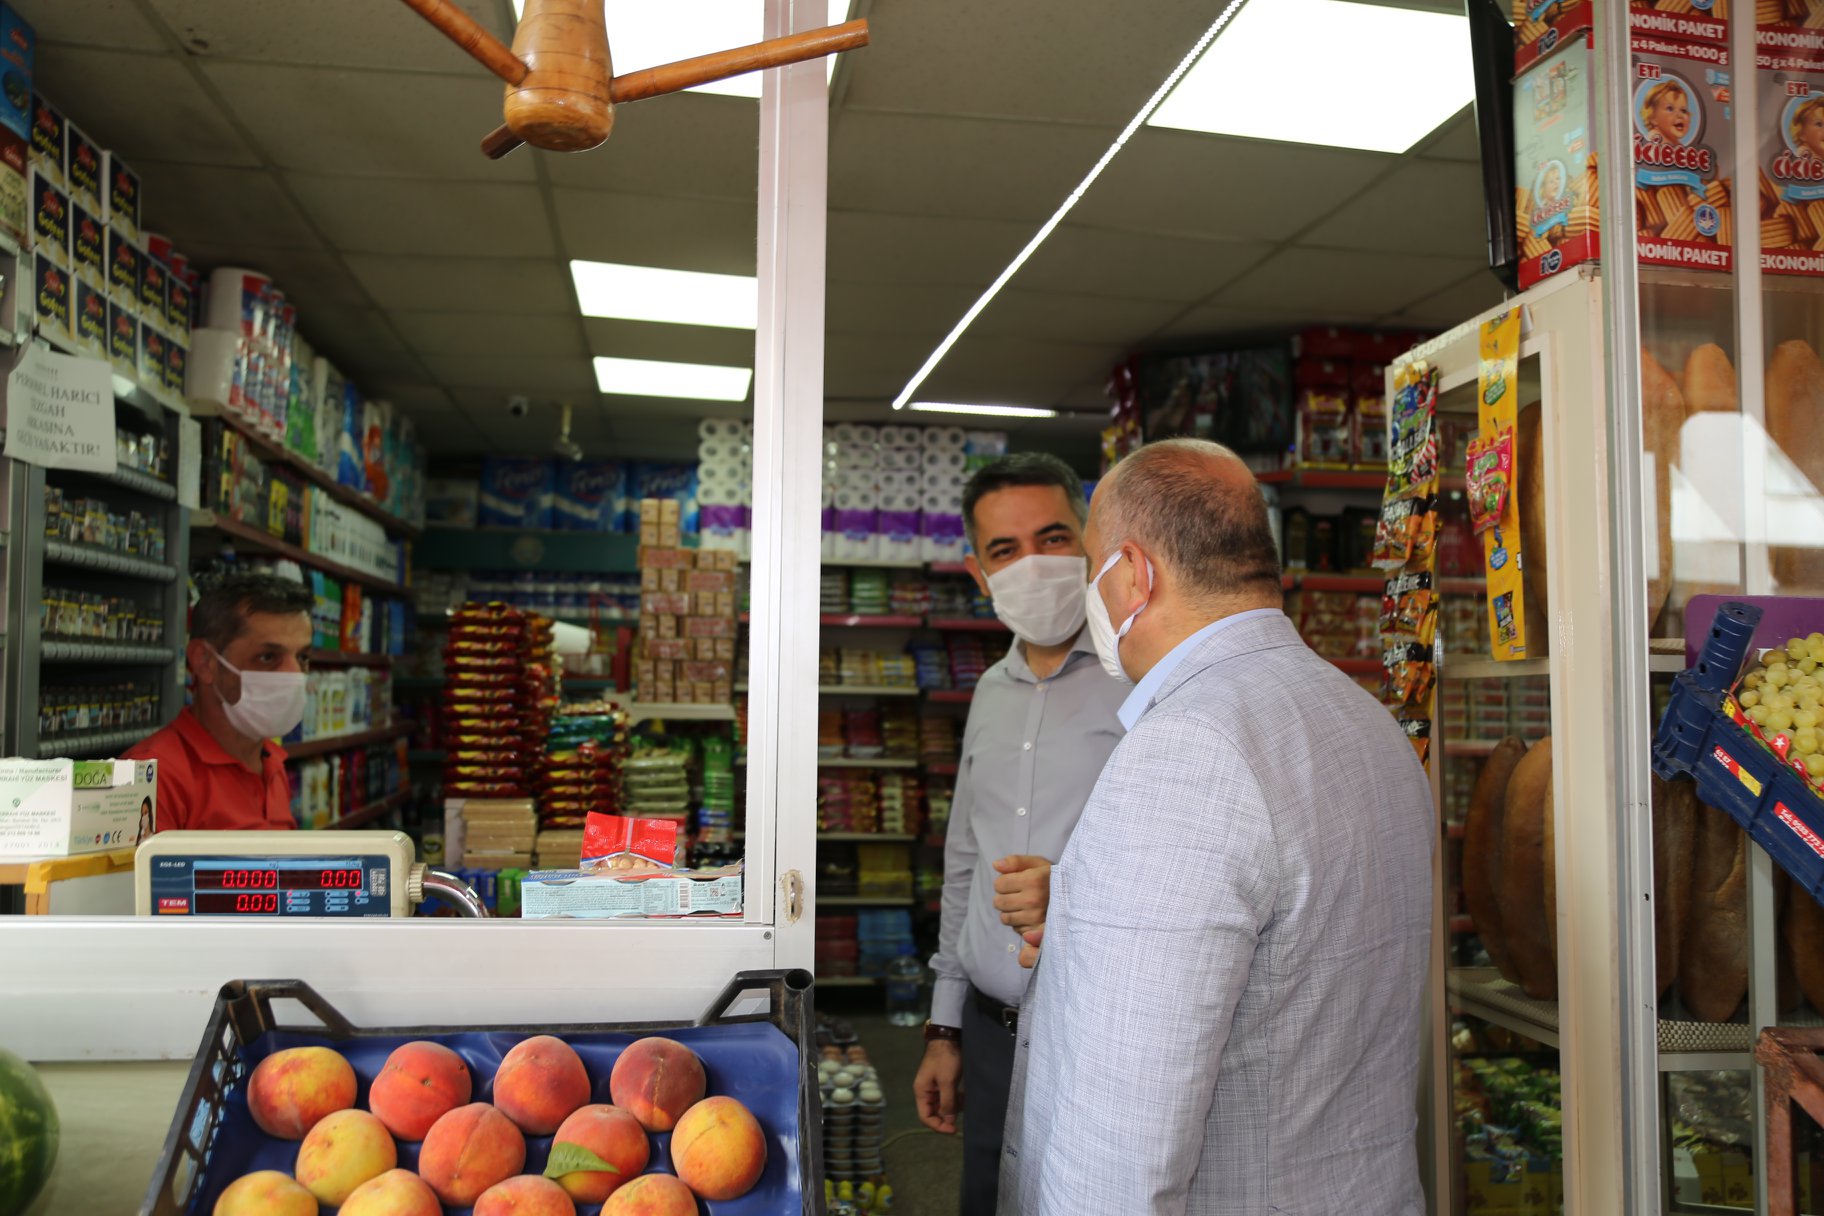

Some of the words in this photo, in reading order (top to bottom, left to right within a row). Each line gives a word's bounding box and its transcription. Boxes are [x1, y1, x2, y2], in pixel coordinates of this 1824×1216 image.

[1630, 13, 1677, 32] NOMİK
[1678, 20, 1725, 39] PAKET
[1640, 38, 1649, 49] 4
[1649, 40, 1678, 54] Paket
[1686, 45, 1718, 60] 1000
[1756, 31, 1824, 49] KONOMİK
[1756, 56, 1771, 66] 50
[1633, 133, 1711, 171] İCİBEBE
[1772, 150, 1824, 180] CİCİB
[1636, 242, 1682, 261] NOMİK
[1683, 248, 1729, 266] PAKET
[1760, 254, 1824, 272] EKONOMİ
[223, 869, 277, 888] 0.000
[321, 870, 361, 888] 0.00
[161, 899, 188, 907] TEM
[236, 894, 277, 912] 0.00
